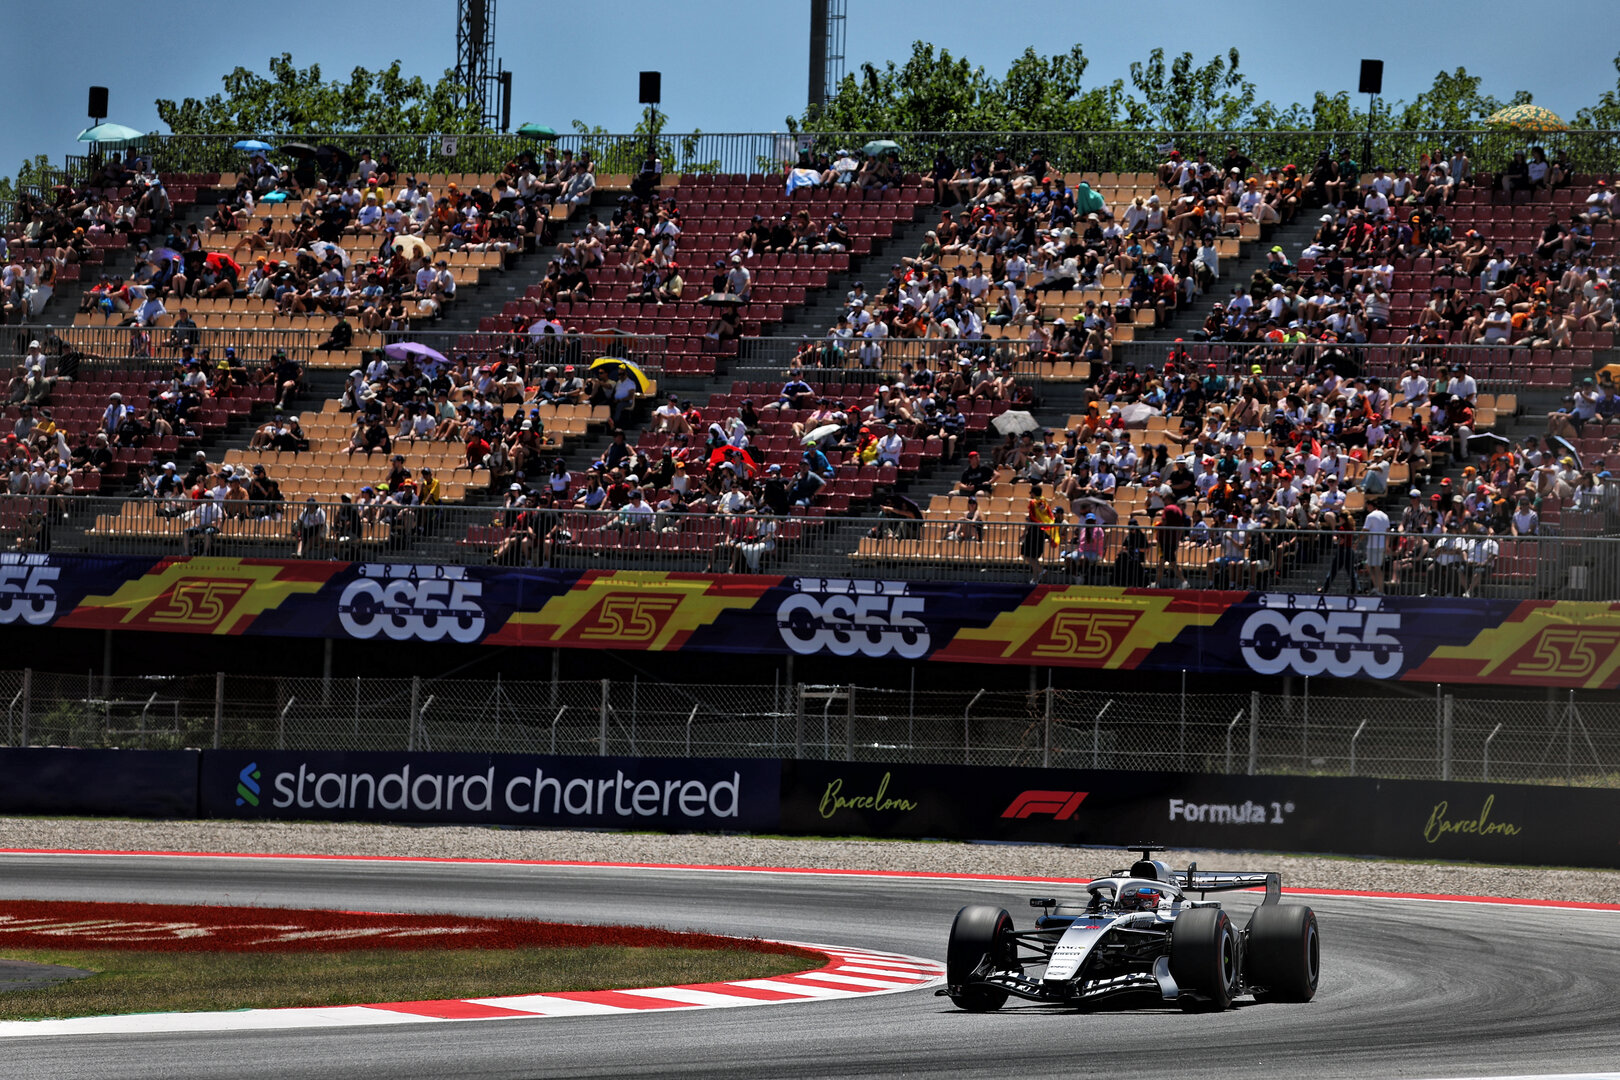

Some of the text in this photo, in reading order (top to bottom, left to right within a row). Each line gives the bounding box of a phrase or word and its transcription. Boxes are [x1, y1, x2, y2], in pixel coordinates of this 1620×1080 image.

[446, 144, 453, 154] 6
[358, 564, 469, 580] GRADA
[793, 578, 910, 595] GRADA
[148, 581, 248, 625] 55
[580, 596, 679, 641] 55
[1258, 594, 1385, 611] GRADA
[1032, 612, 1136, 659] 55
[1510, 629, 1620, 677] 55
[272, 763, 740, 817] standard chartered
[819, 772, 917, 818] Barcelona
[1000, 790, 1090, 820] F1
[1169, 799, 1266, 824] Formula
[1424, 794, 1521, 843] Barcelona
